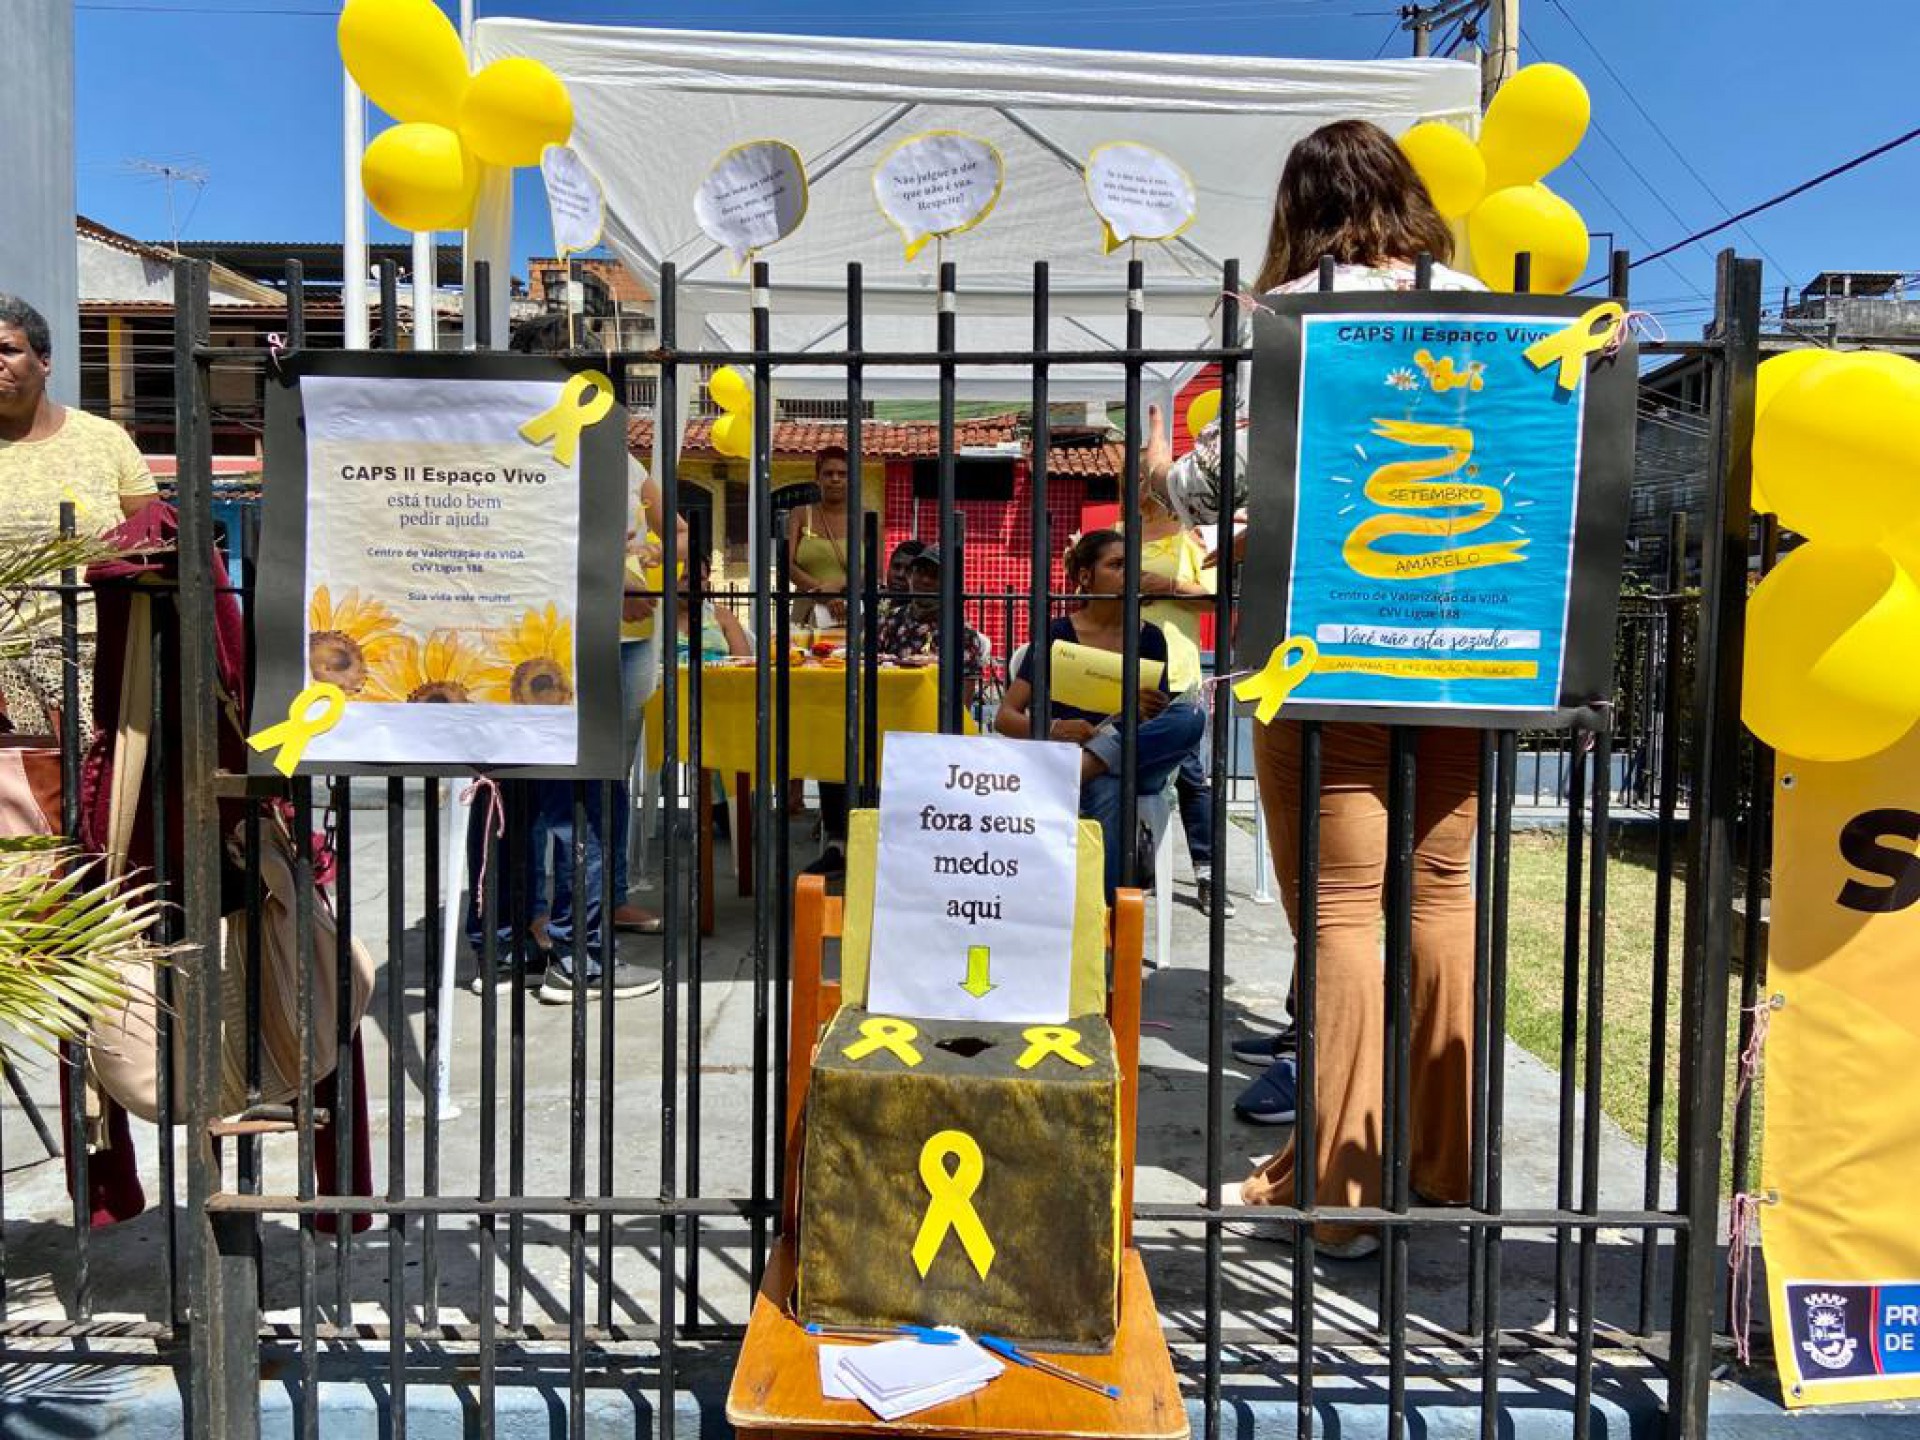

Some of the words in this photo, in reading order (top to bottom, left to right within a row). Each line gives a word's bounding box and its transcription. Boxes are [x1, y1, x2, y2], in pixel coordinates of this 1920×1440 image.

[917, 168, 949, 183] julgue
[903, 189, 921, 200] que
[924, 184, 943, 195] não
[1338, 326, 1394, 342] CAPS
[1402, 327, 1414, 342] II
[1422, 327, 1497, 346] Espaço
[341, 466, 397, 481] CAPS
[404, 466, 415, 481] II
[423, 467, 496, 486] Espaço
[503, 468, 547, 484] Vivo
[387, 492, 419, 508] está
[425, 493, 462, 508] tudo
[467, 494, 502, 509] bem
[1388, 487, 1484, 502] SETEMBRO
[400, 511, 441, 528] pedir
[446, 512, 489, 528] ajuda
[367, 547, 403, 558] Centro
[405, 549, 418, 558] de
[422, 548, 480, 560] Valorização
[484, 549, 496, 559] da
[500, 550, 524, 559] VIDA
[1395, 551, 1480, 573] AMARELO
[412, 562, 433, 573] CVV
[435, 562, 463, 574] Ligue
[467, 563, 483, 573] 188
[408, 591, 427, 601] Sua
[431, 591, 450, 601] vida
[451, 592, 474, 601] vale
[478, 592, 511, 602] muito!
[1329, 589, 1370, 600] Centro
[1373, 590, 1388, 600] de
[1391, 591, 1458, 605] Valorização
[1461, 592, 1476, 602] da
[1479, 593, 1508, 604] VIDA
[1380, 607, 1402, 618] CVV
[1405, 607, 1436, 620] Ligue
[1440, 608, 1460, 619] 188
[1342, 625, 1376, 645] Você
[1380, 633, 1407, 646] não
[1413, 629, 1447, 649] está
[1450, 624, 1509, 651] sozinho
[945, 765, 1021, 796] Jogue
[920, 805, 973, 832] fora
[980, 813, 1036, 834] seus
[934, 851, 1019, 877] medos
[1837, 807, 1920, 914] S
[946, 895, 1002, 925] aqui
[1885, 1332, 1915, 1352] DE
